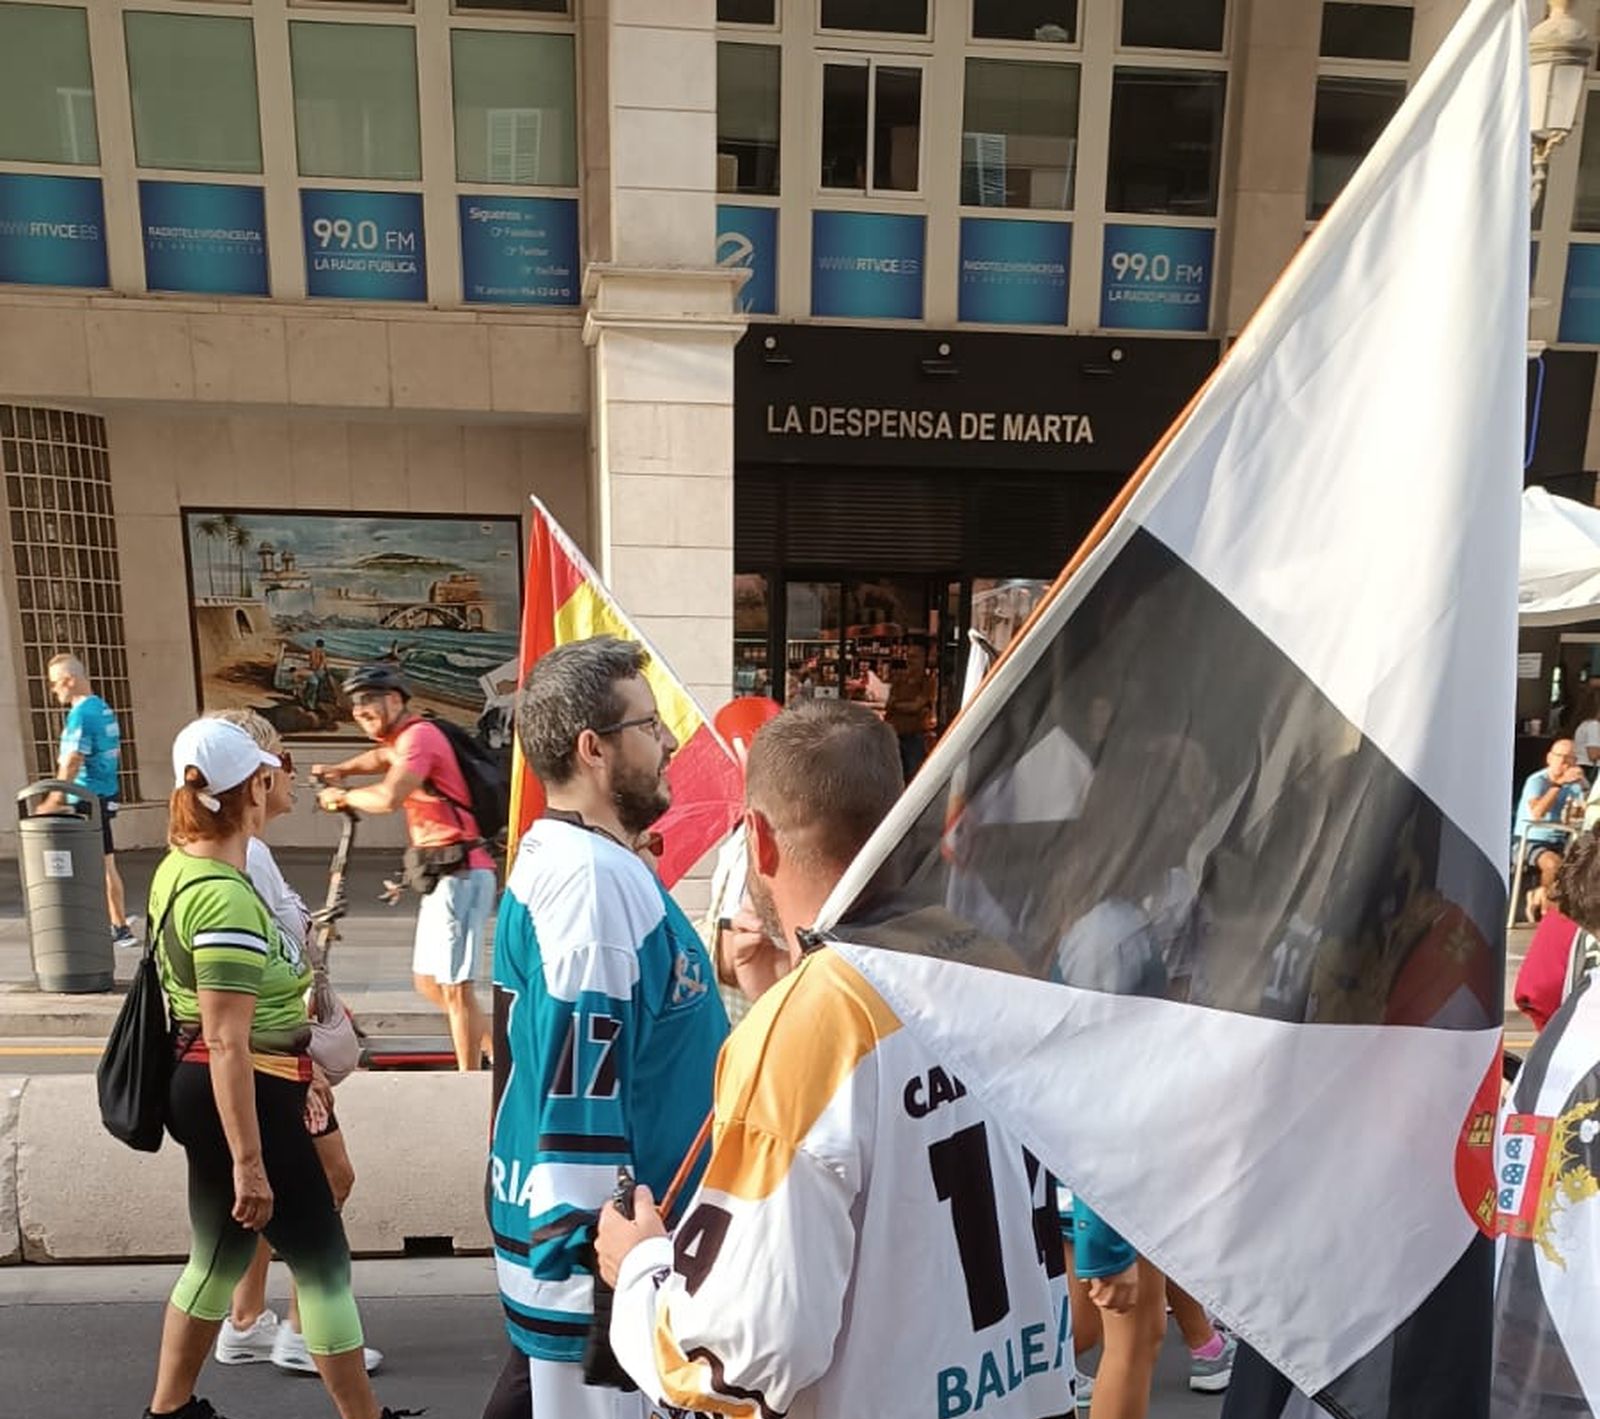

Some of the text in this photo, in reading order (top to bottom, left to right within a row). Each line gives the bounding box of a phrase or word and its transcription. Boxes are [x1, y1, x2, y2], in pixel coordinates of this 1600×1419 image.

[312, 218, 416, 252] 99.0 FM
[1111, 252, 1203, 284] 99.0 FM
[767, 404, 1094, 444] LA DESPENSA DE MARTA
[547, 1010, 624, 1101] 17
